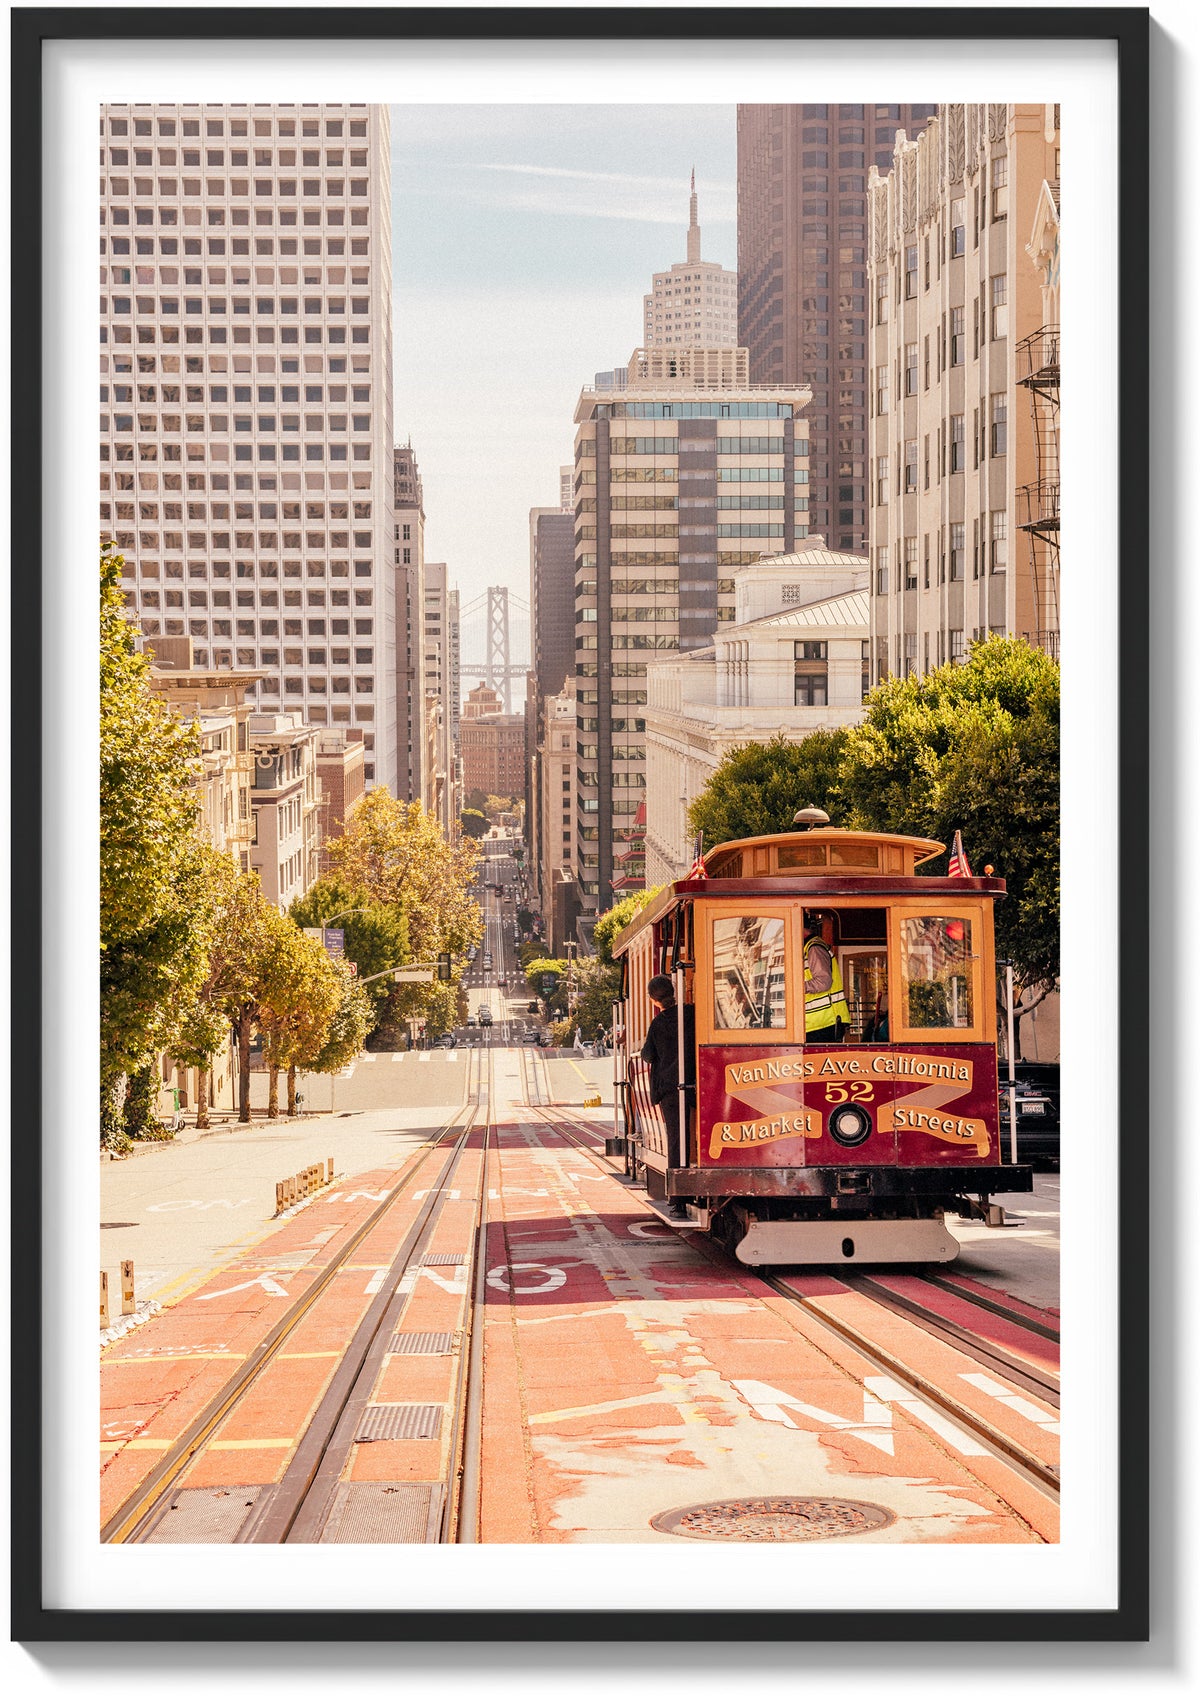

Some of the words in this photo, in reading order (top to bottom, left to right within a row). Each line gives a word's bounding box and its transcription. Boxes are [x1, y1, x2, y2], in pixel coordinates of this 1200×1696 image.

[730, 1066, 764, 1084] Van
[766, 1060, 815, 1078] Ness
[872, 1056, 969, 1081] California
[825, 1081, 875, 1103] 52
[721, 1124, 736, 1142] &
[739, 1114, 812, 1142] Market
[893, 1109, 975, 1138] Streets
